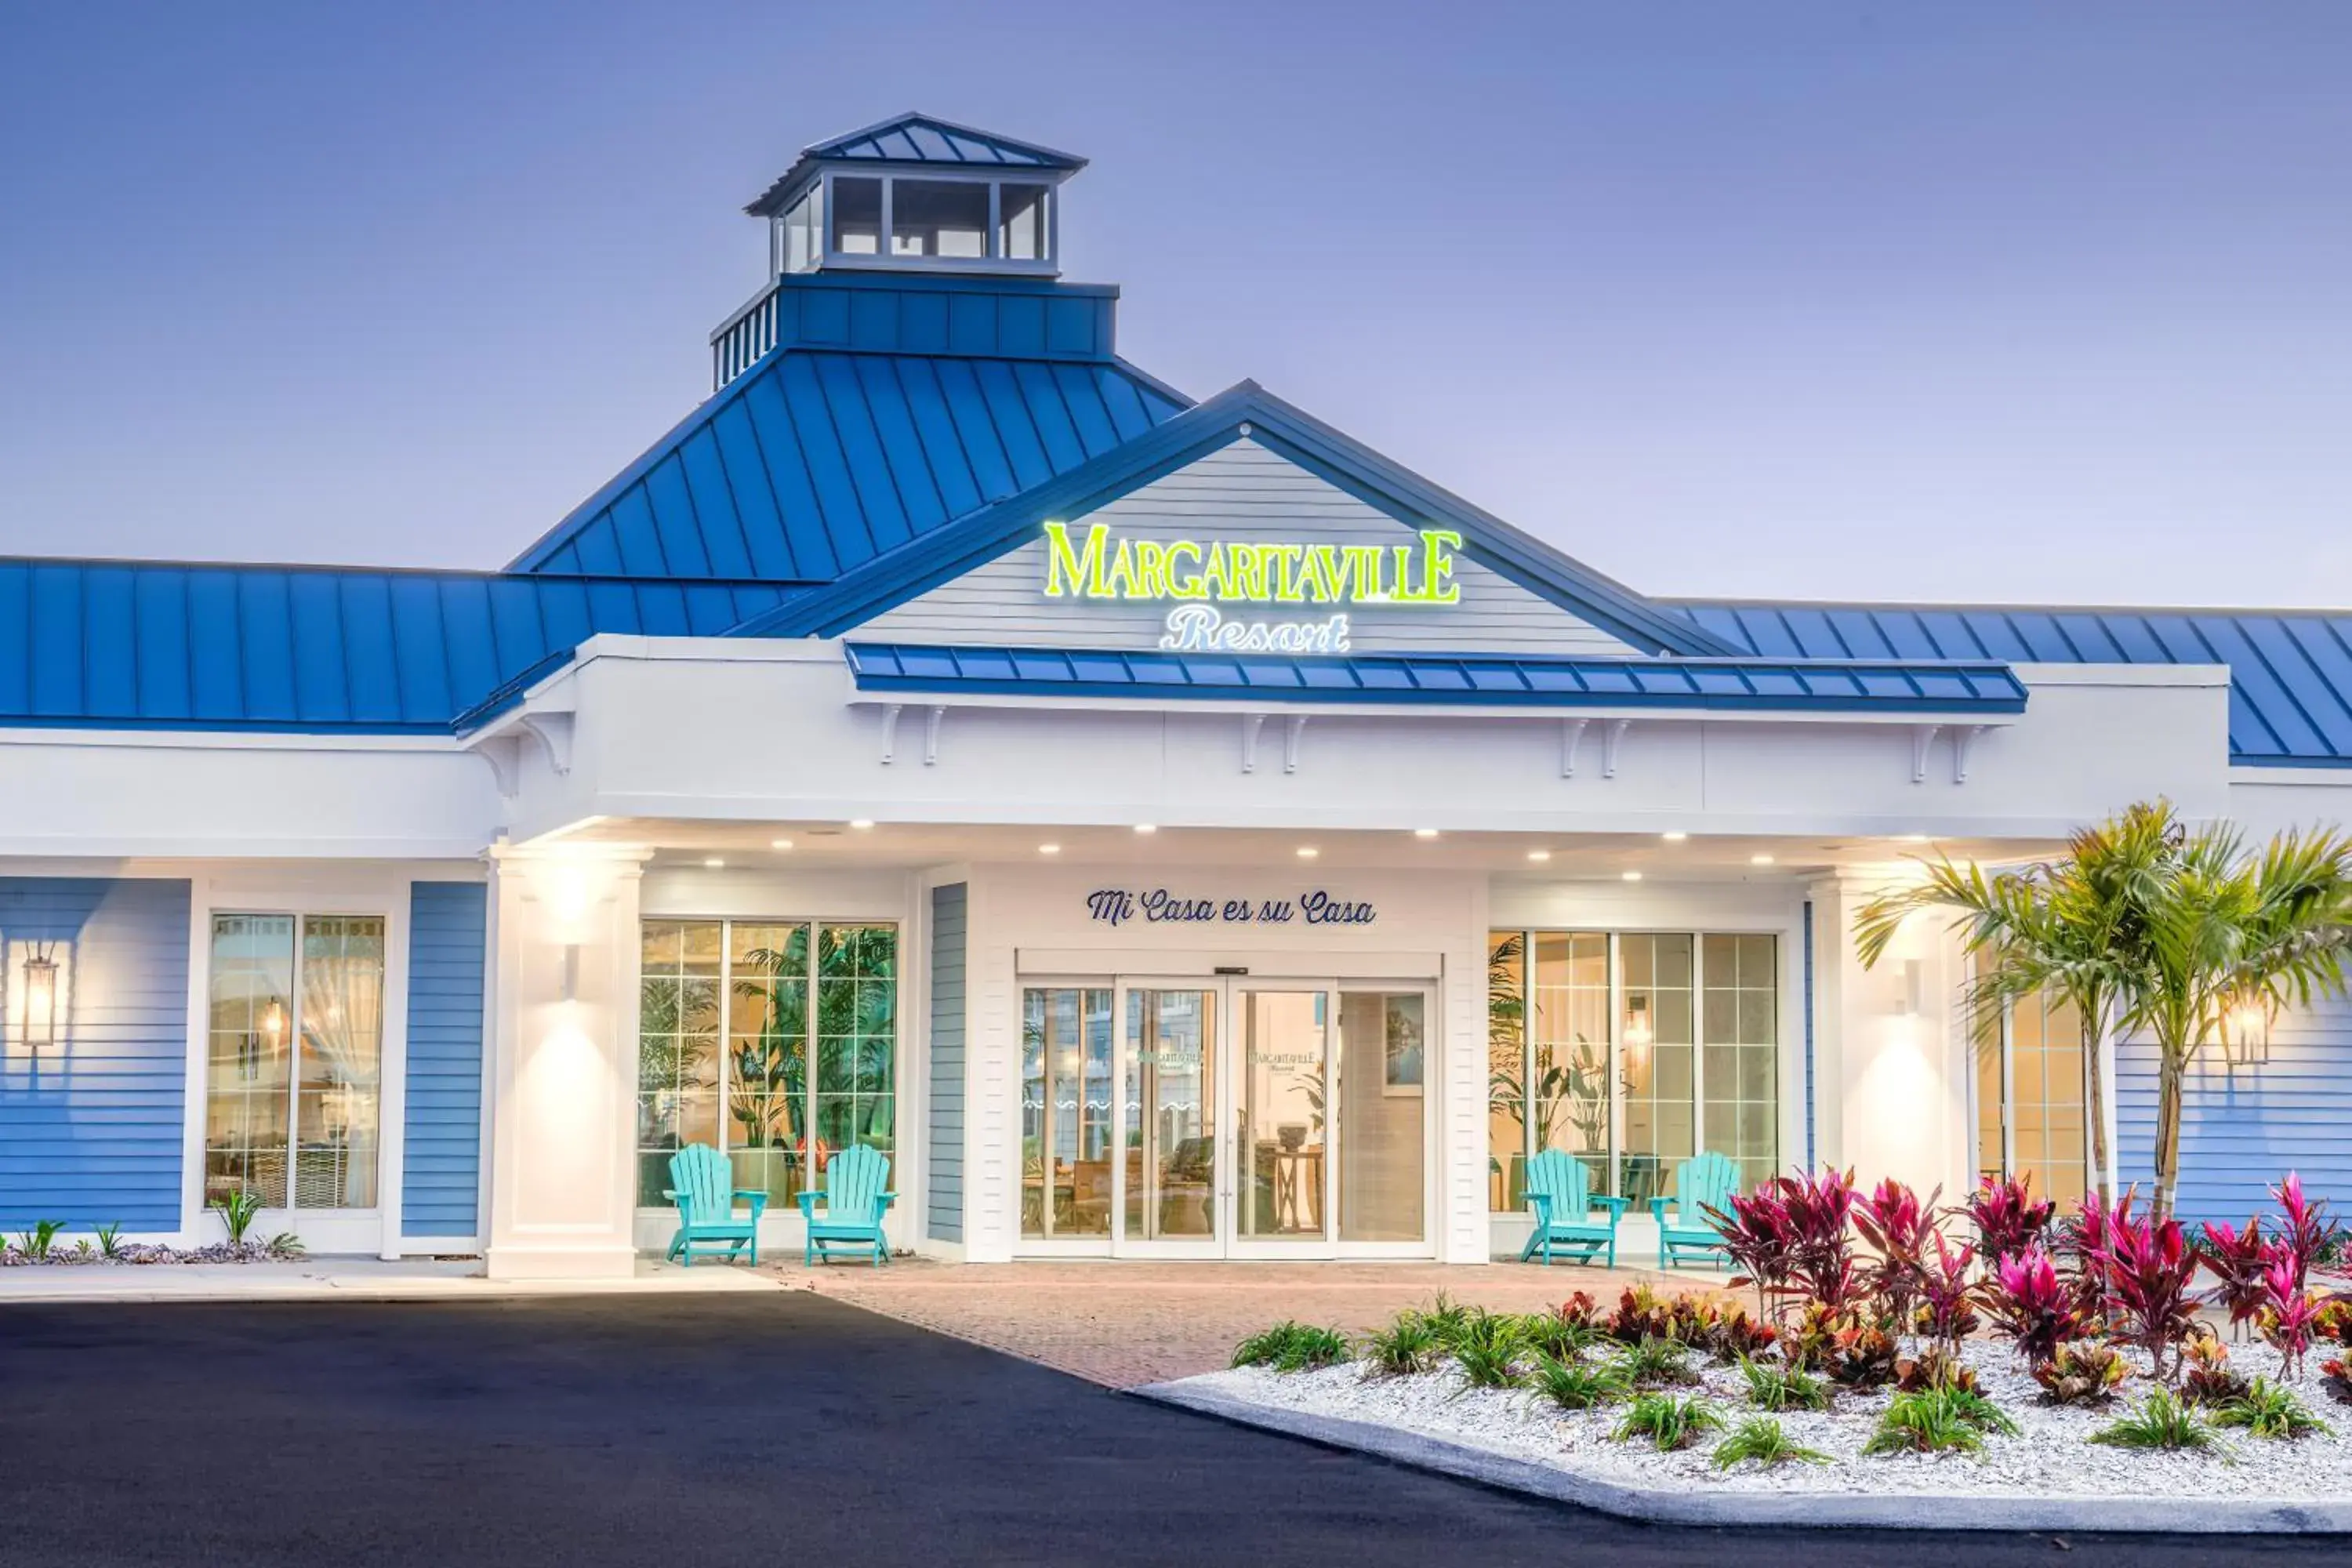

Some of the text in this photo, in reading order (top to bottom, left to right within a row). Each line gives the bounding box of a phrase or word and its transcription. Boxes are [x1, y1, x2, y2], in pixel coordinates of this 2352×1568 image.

[1044, 523, 1461, 604] MARGARITAVILLE
[1160, 605, 1352, 653] Resort
[1087, 888, 1376, 926] Mi Casa es su Casa
